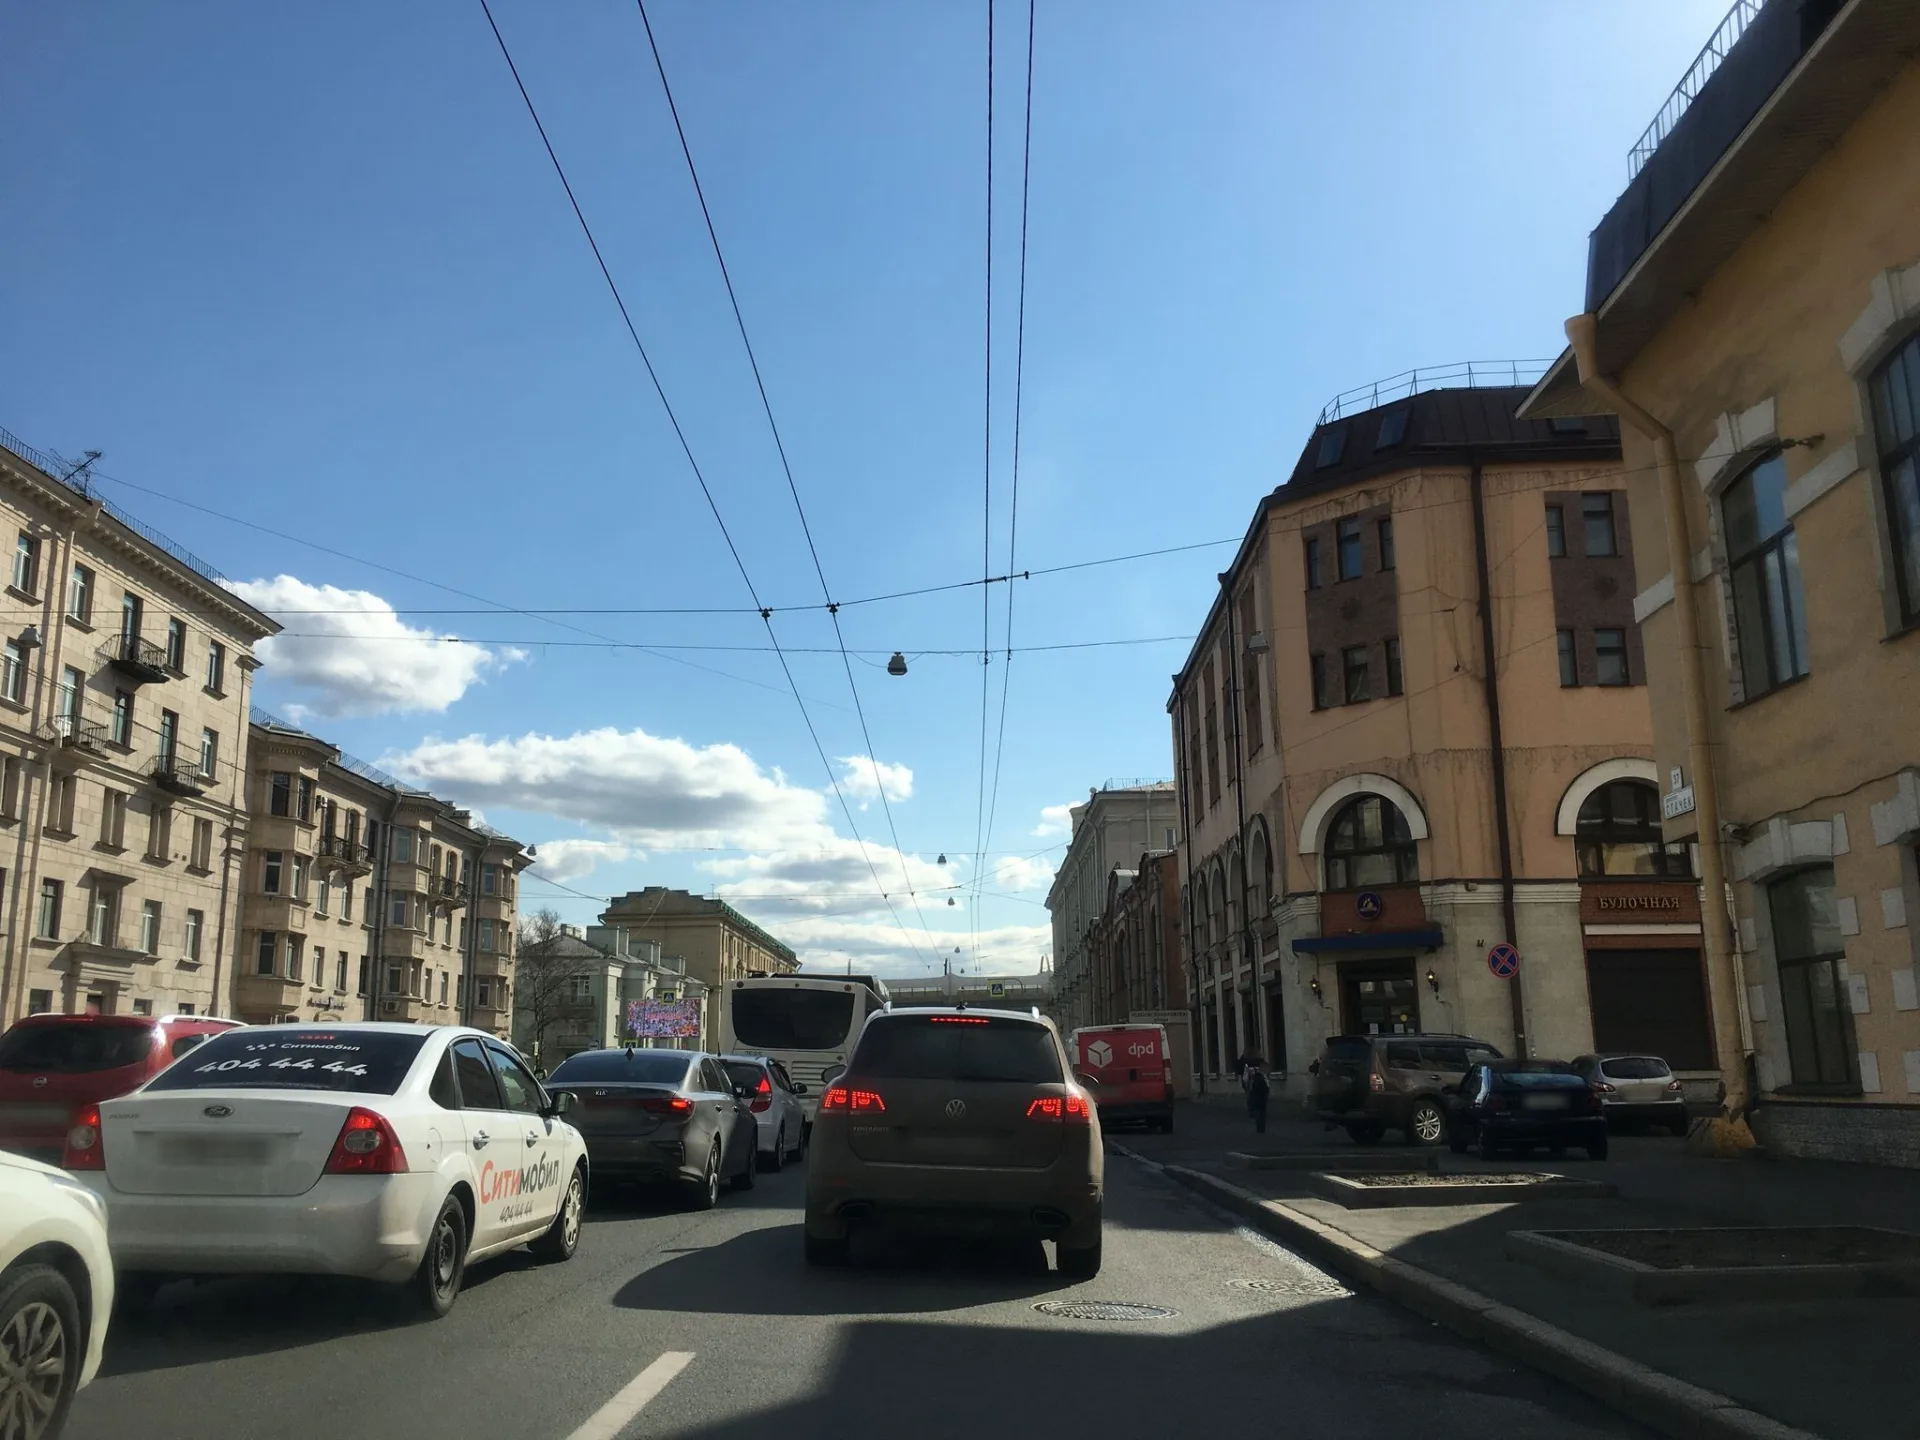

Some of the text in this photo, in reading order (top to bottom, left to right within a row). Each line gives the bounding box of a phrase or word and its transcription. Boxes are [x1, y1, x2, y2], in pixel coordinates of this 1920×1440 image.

[1665, 796, 1693, 816] СТАЧЕК
[1599, 897, 1680, 909] БУЛОЧНАЯ
[281, 1042, 361, 1051] Ситимобил
[1128, 1041, 1154, 1057] dpd
[193, 1058, 367, 1076] 404 44 44
[481, 1151, 559, 1204] Ситимобил
[500, 1206, 513, 1222] 404
